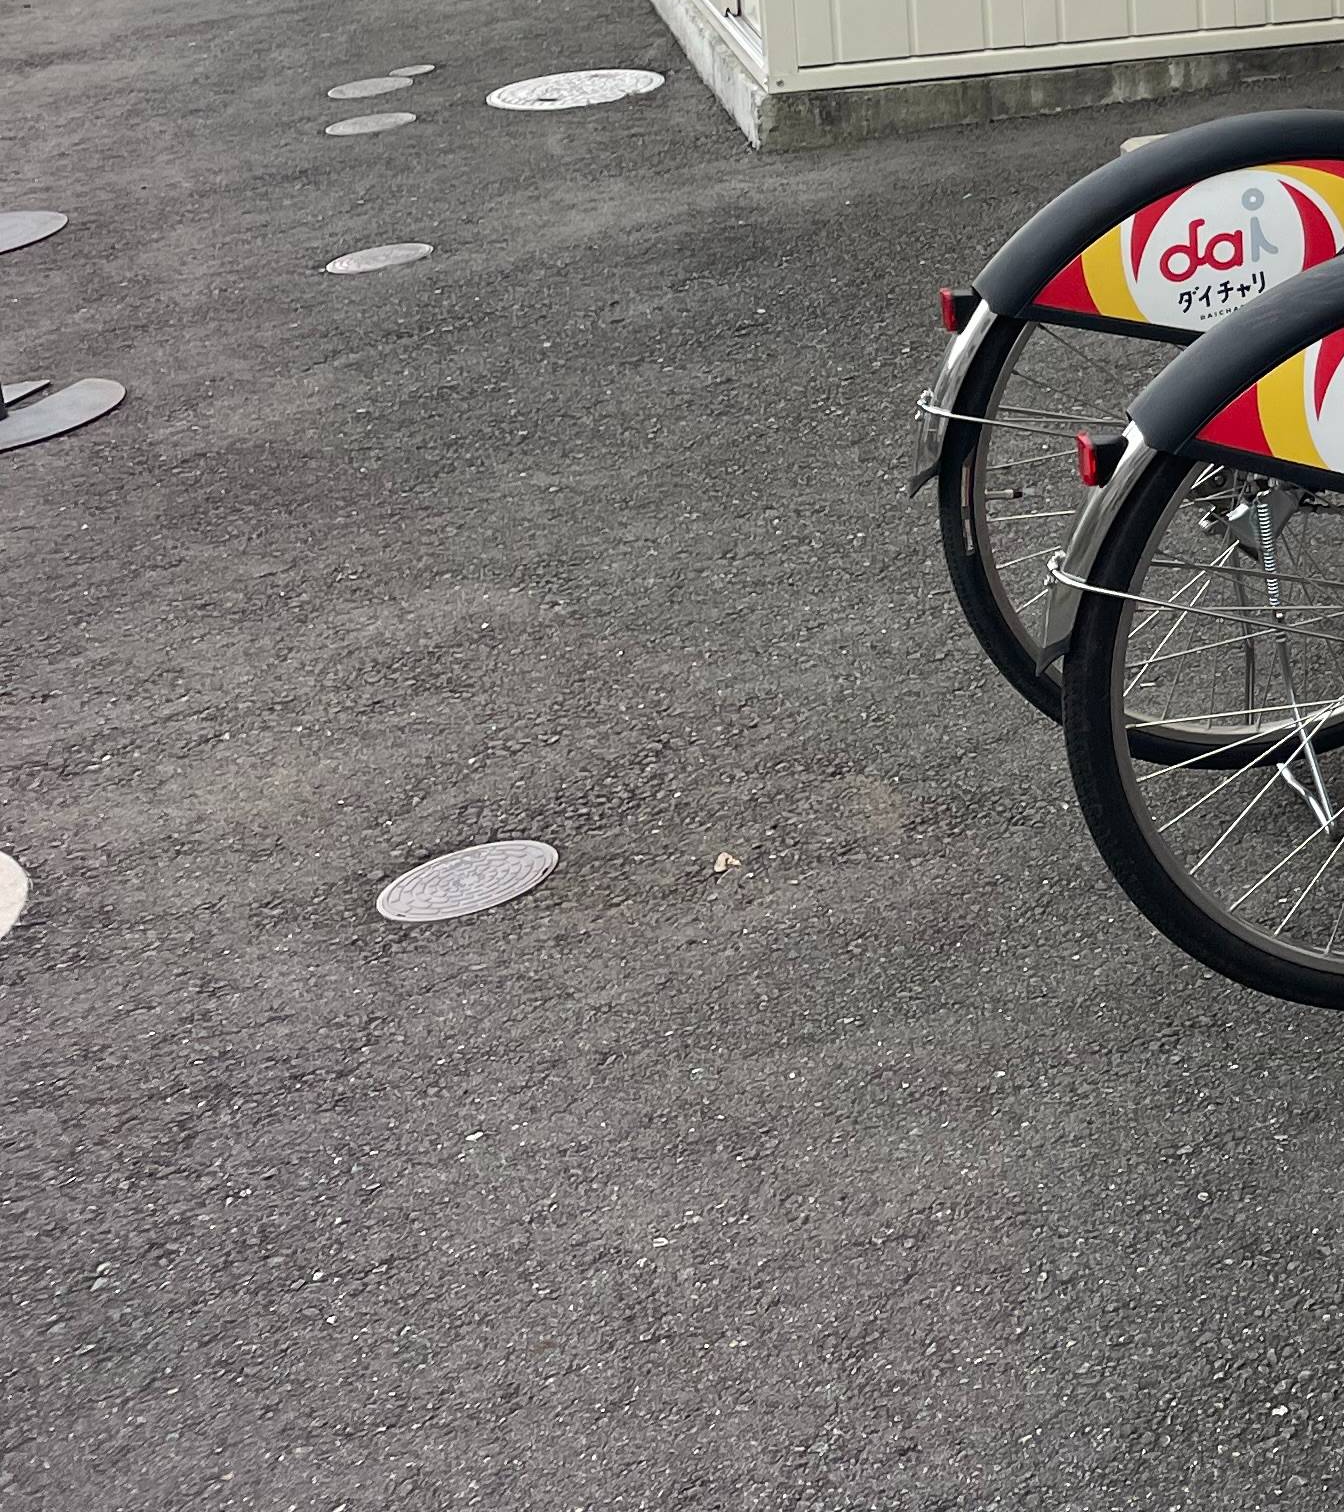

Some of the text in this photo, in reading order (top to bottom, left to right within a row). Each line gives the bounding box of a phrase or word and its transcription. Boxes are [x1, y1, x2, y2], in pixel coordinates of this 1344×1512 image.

[1159, 187, 1279, 283] dai
[1178, 270, 1267, 314] ダイチャリ
[1200, 304, 1246, 321] DAICHA
